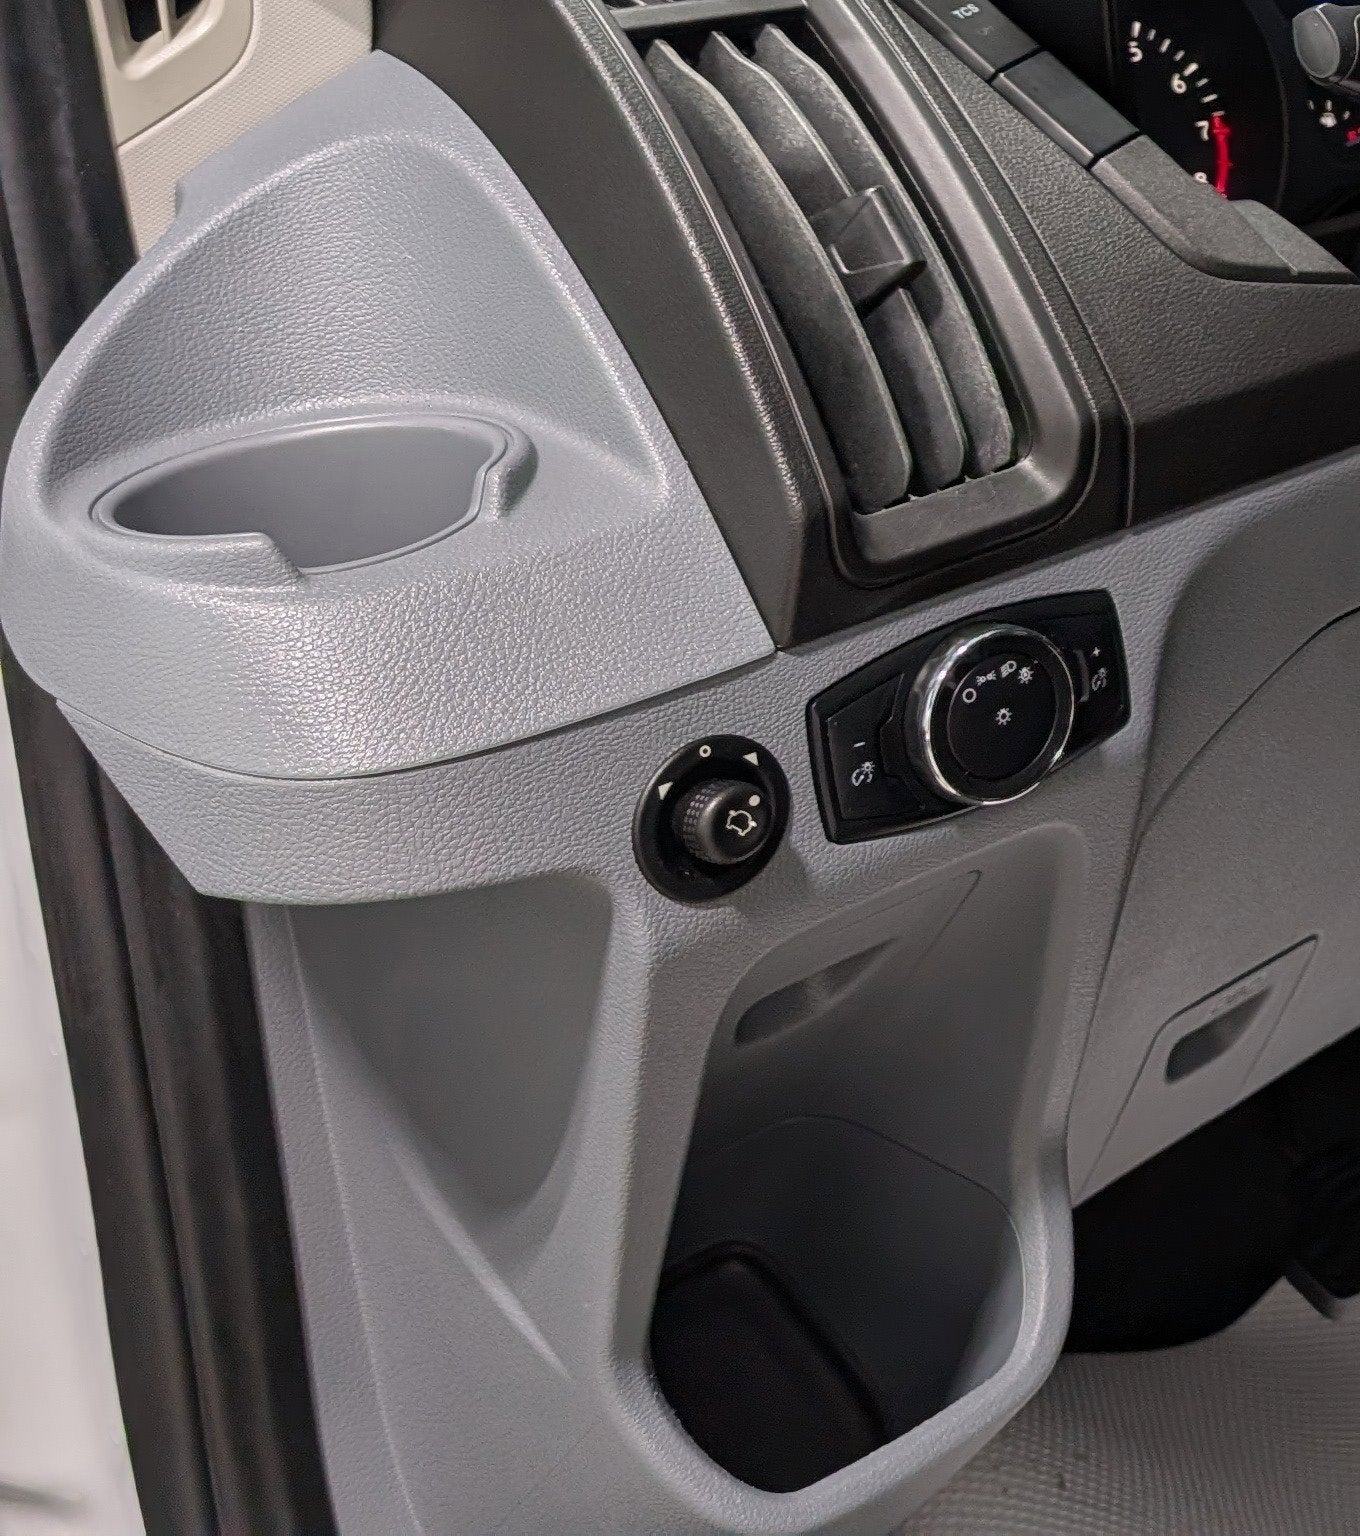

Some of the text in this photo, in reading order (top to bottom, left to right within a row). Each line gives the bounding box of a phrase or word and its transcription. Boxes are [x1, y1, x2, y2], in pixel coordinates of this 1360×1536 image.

[951, 3, 980, 19] TCS
[1127, 40, 1144, 63] 5
[1170, 72, 1188, 95] 6
[1194, 120, 1210, 141] 7
